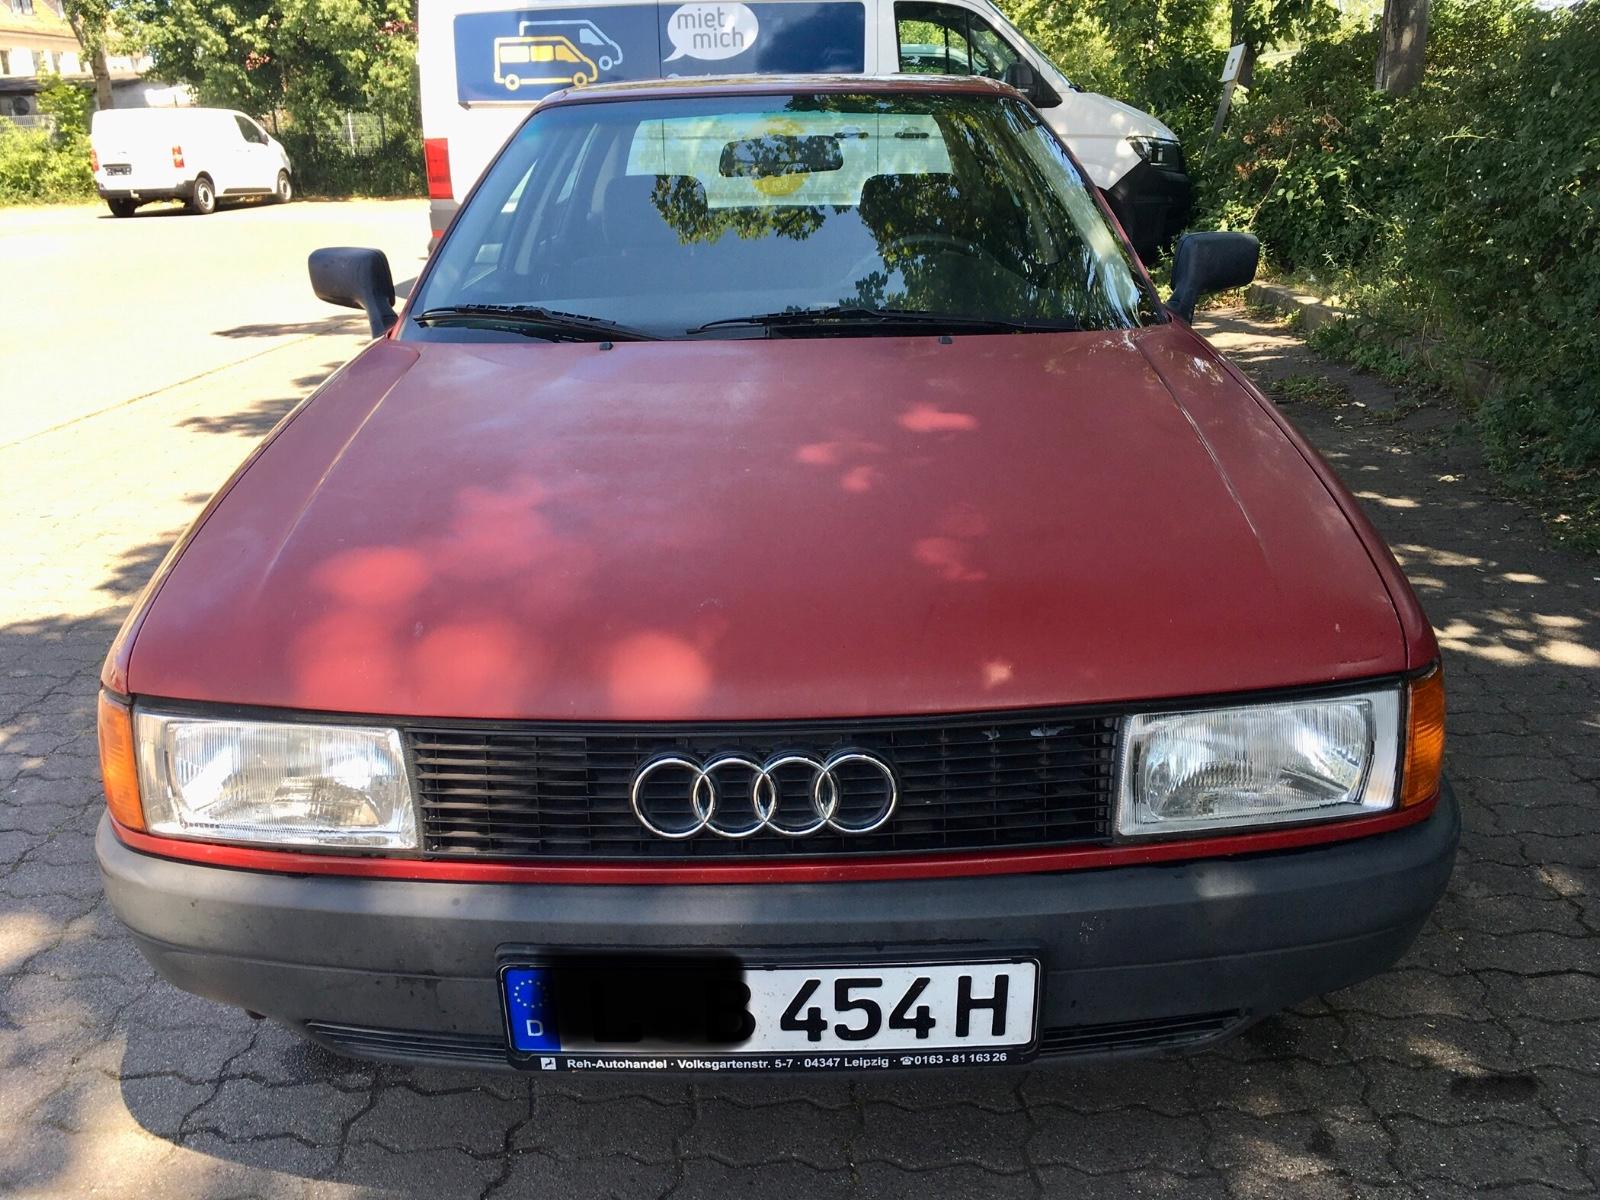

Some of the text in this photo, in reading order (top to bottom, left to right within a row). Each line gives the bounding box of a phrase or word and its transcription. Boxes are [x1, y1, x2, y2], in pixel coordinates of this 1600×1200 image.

[676, 7, 726, 29] miet
[692, 26, 745, 49] mich
[780, 976, 937, 1042] 454
[955, 974, 1009, 1038] H
[526, 1019, 544, 1037] D
[566, 1059, 667, 1070] Reh-Autohandel
[677, 1058, 771, 1070] Volksgartenstr.
[774, 1058, 794, 1068] 5-7
[804, 1057, 841, 1068] 04347
[844, 1056, 889, 1069] Leipzig
